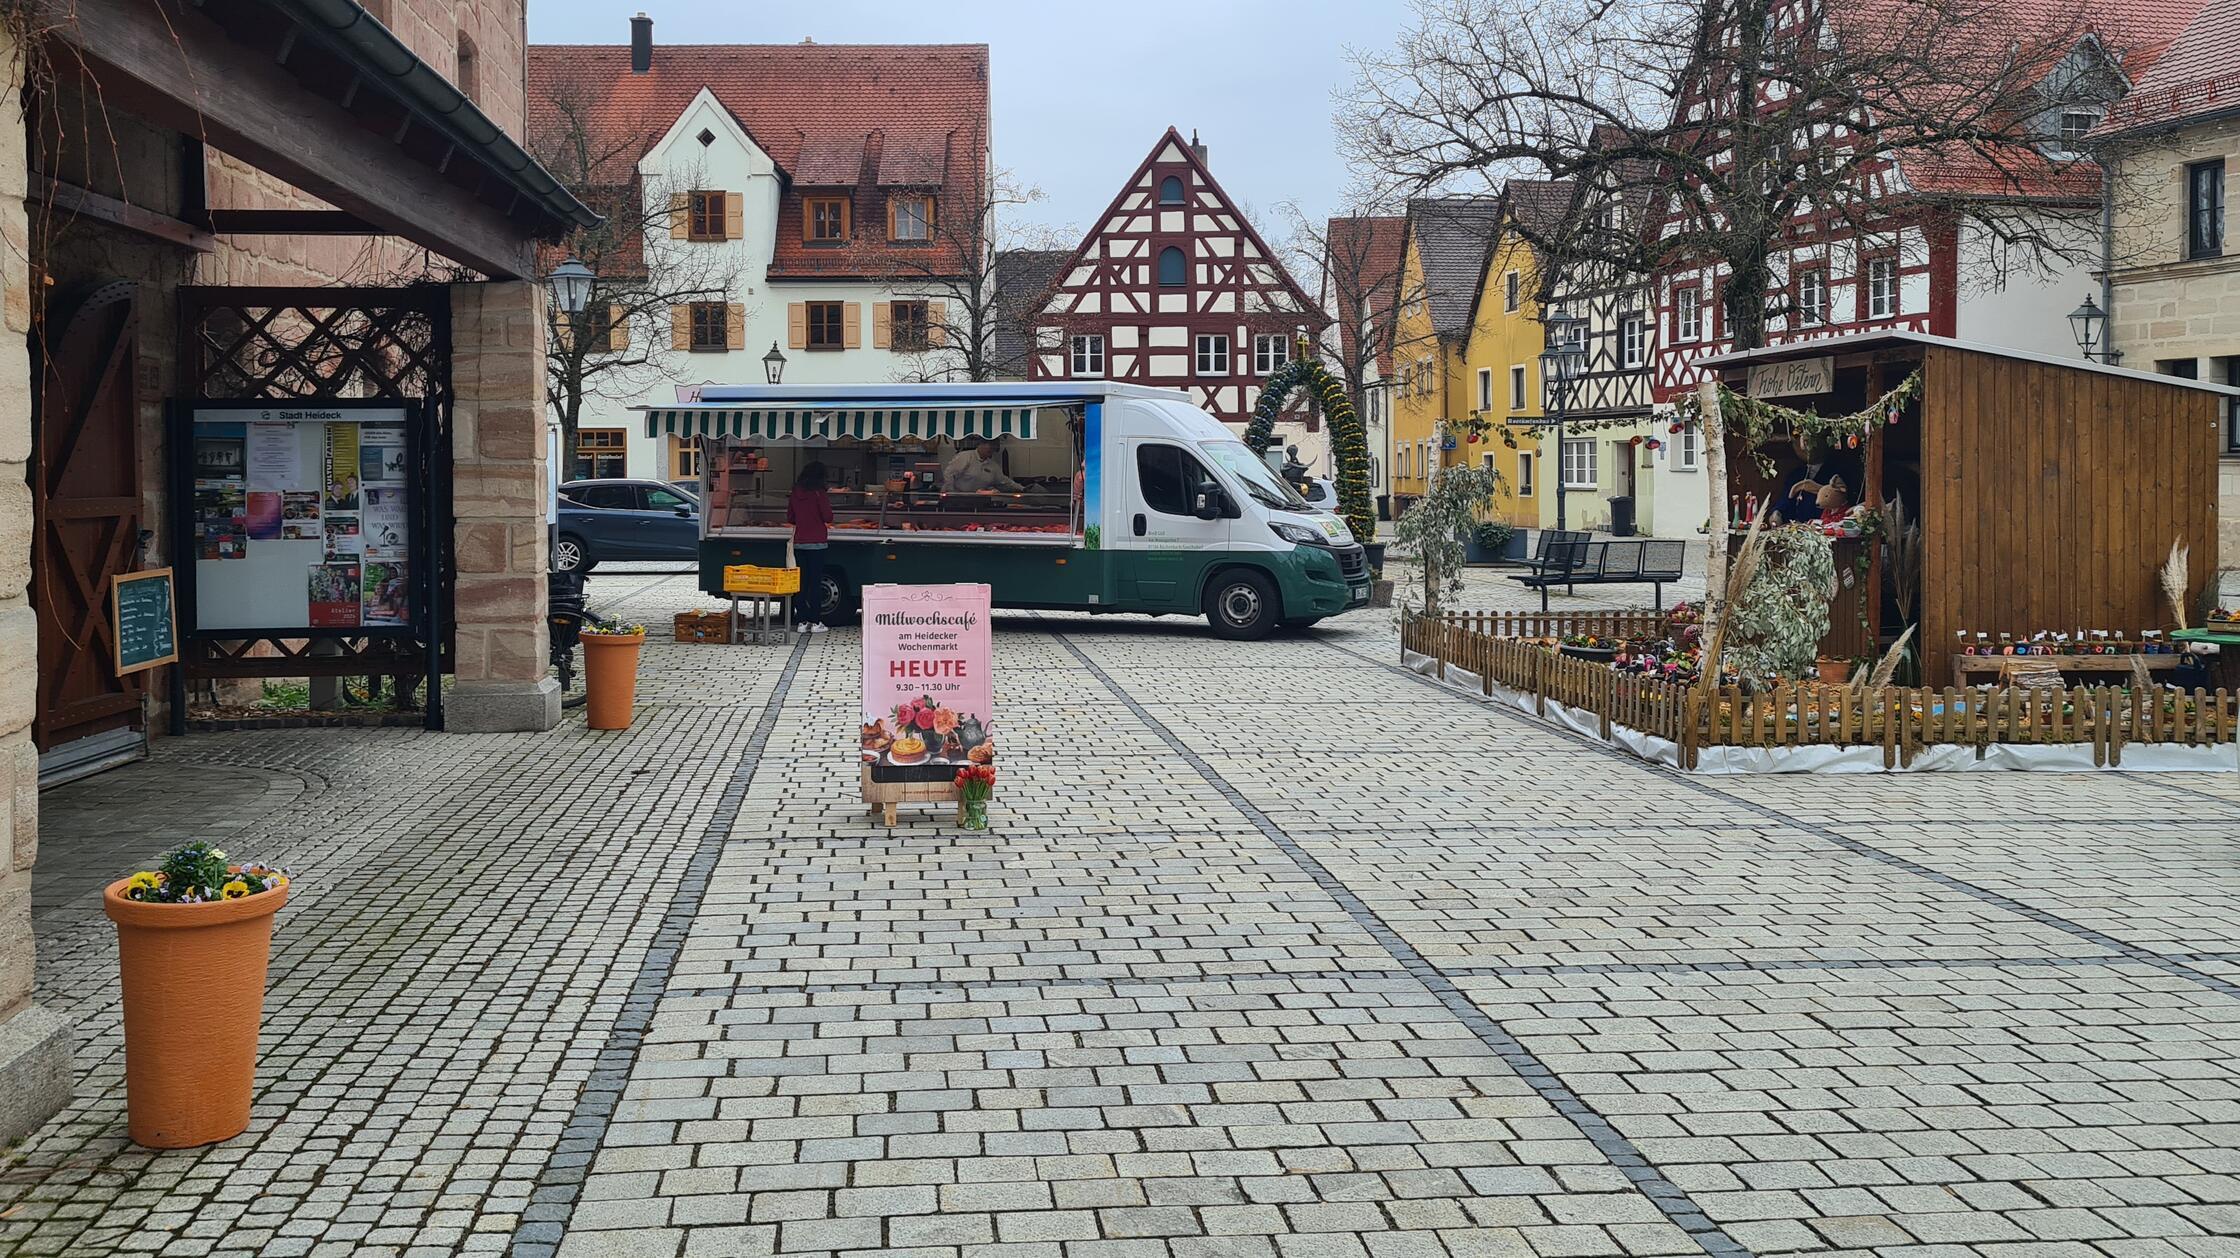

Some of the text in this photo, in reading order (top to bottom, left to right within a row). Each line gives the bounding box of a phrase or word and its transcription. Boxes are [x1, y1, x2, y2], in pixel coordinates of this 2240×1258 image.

[1756, 363, 1823, 396] Frohe Ostern
[279, 411, 342, 420] Stadt Heideck
[325, 458, 333, 492] KULTUR
[875, 611, 977, 631] Mittwochscafé
[914, 632, 958, 640] Heidecker
[898, 643, 958, 651] Wochenmarkt
[890, 660, 967, 677] HEUTE
[896, 683, 914, 691] 9.30
[921, 683, 943, 691] 11.30
[945, 683, 961, 691] Uhr
